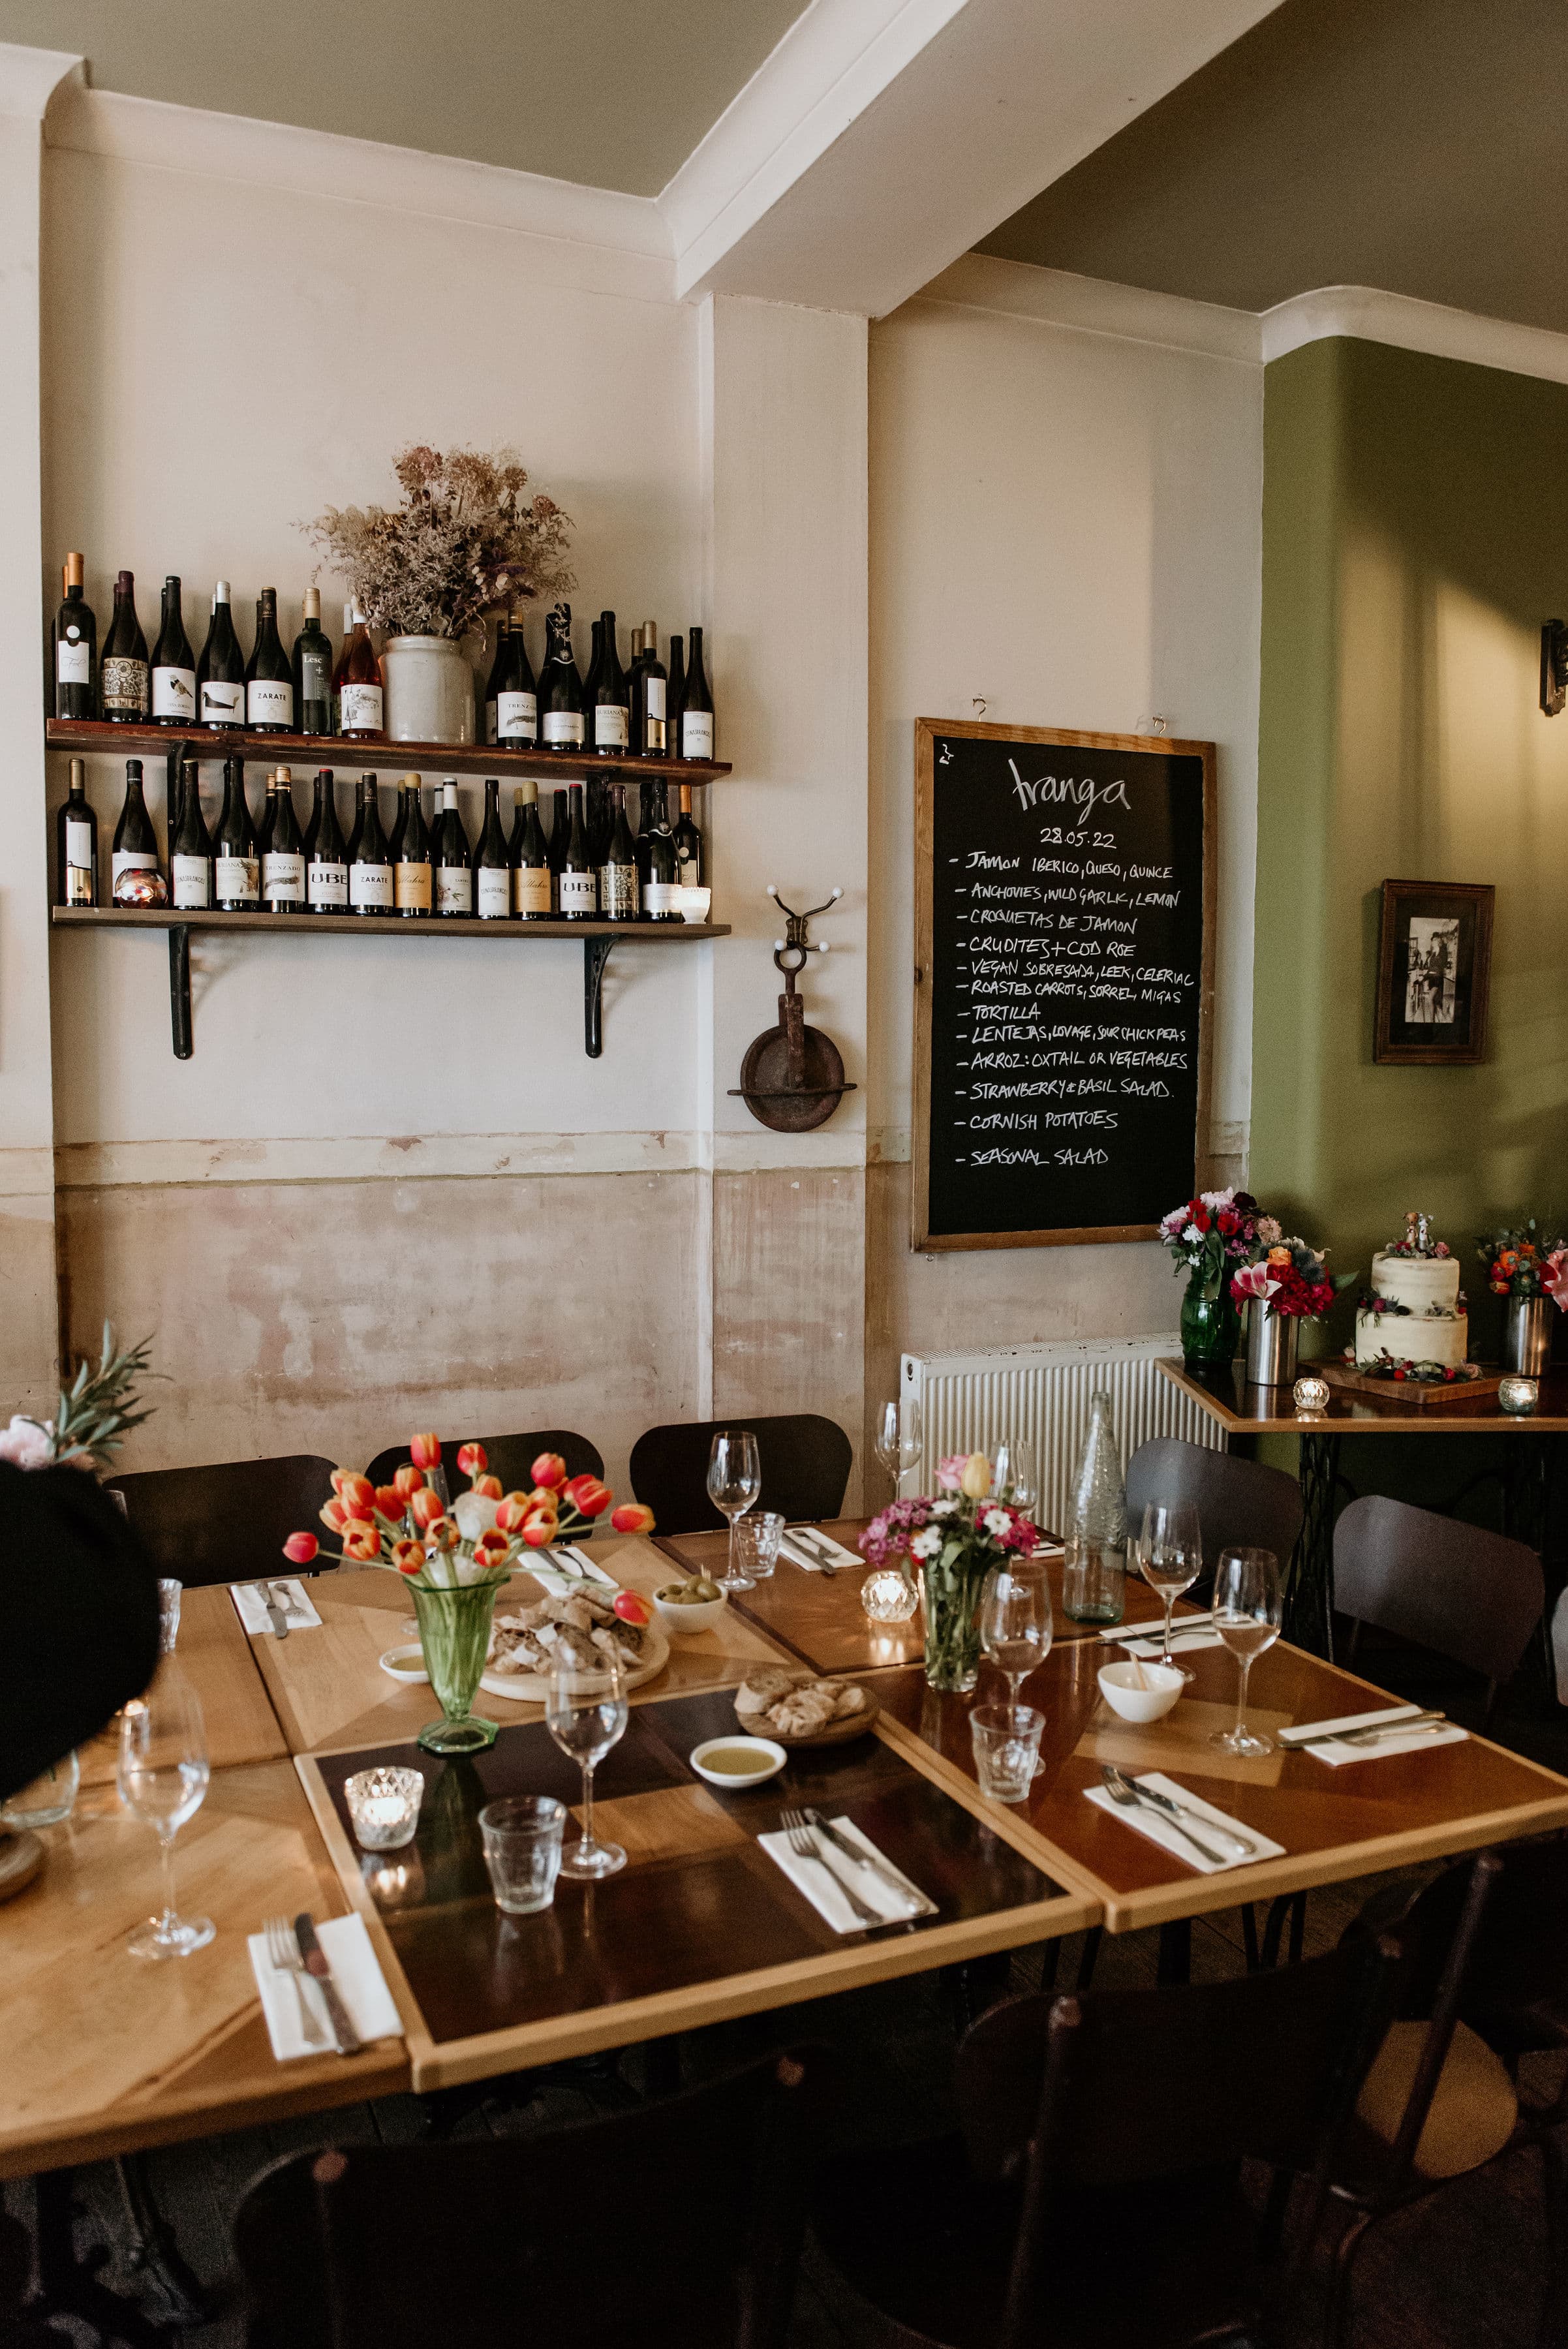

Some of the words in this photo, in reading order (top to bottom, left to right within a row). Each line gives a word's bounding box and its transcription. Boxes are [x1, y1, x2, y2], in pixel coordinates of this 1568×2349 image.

[304, 655, 322, 664] Lesc
[1040, 827, 1117, 849] 28.05.22
[965, 851, 1020, 870] JAMON
[1032, 857, 1084, 880] IBERICO,
[1086, 860, 1127, 882] QUESO,
[1130, 865, 1173, 879] QUINCE
[312, 873, 348, 885] UBE
[563, 882, 596, 893] UBE
[971, 882, 1048, 904] ANCHOVIES,
[1048, 887, 1077, 901] WILD
[1135, 891, 1181, 908] LEMON
[970, 909, 1054, 929] CROQUETAS
[1058, 915, 1078, 929] DE
[1080, 915, 1138, 934] JAMON
[1107, 942, 1137, 958] ROE
[972, 958, 1018, 978] VEGAN
[1135, 968, 1195, 986] CELERIAC
[971, 979, 1032, 996] ROASTED
[1035, 982, 1086, 1000] CARROTS,
[1088, 984, 1137, 1001] SORREL,
[1141, 989, 1182, 1006] MIGAS
[972, 1002, 1041, 1021] TORTILLA
[971, 1052, 1030, 1070] ARROZ:
[1032, 1051, 1086, 1067] OXTAIL
[1089, 1052, 1107, 1065] OR
[1109, 1051, 1188, 1069] VEGETABLES
[970, 1079, 1066, 1099] STRAWBERRY
[1077, 1079, 1118, 1096] BASIL
[970, 1113, 1037, 1130] CORNISH
[1045, 1110, 1118, 1129] POTATOES
[970, 1148, 1050, 1166] SEASONAL
[1054, 1148, 1109, 1166] SALAD
